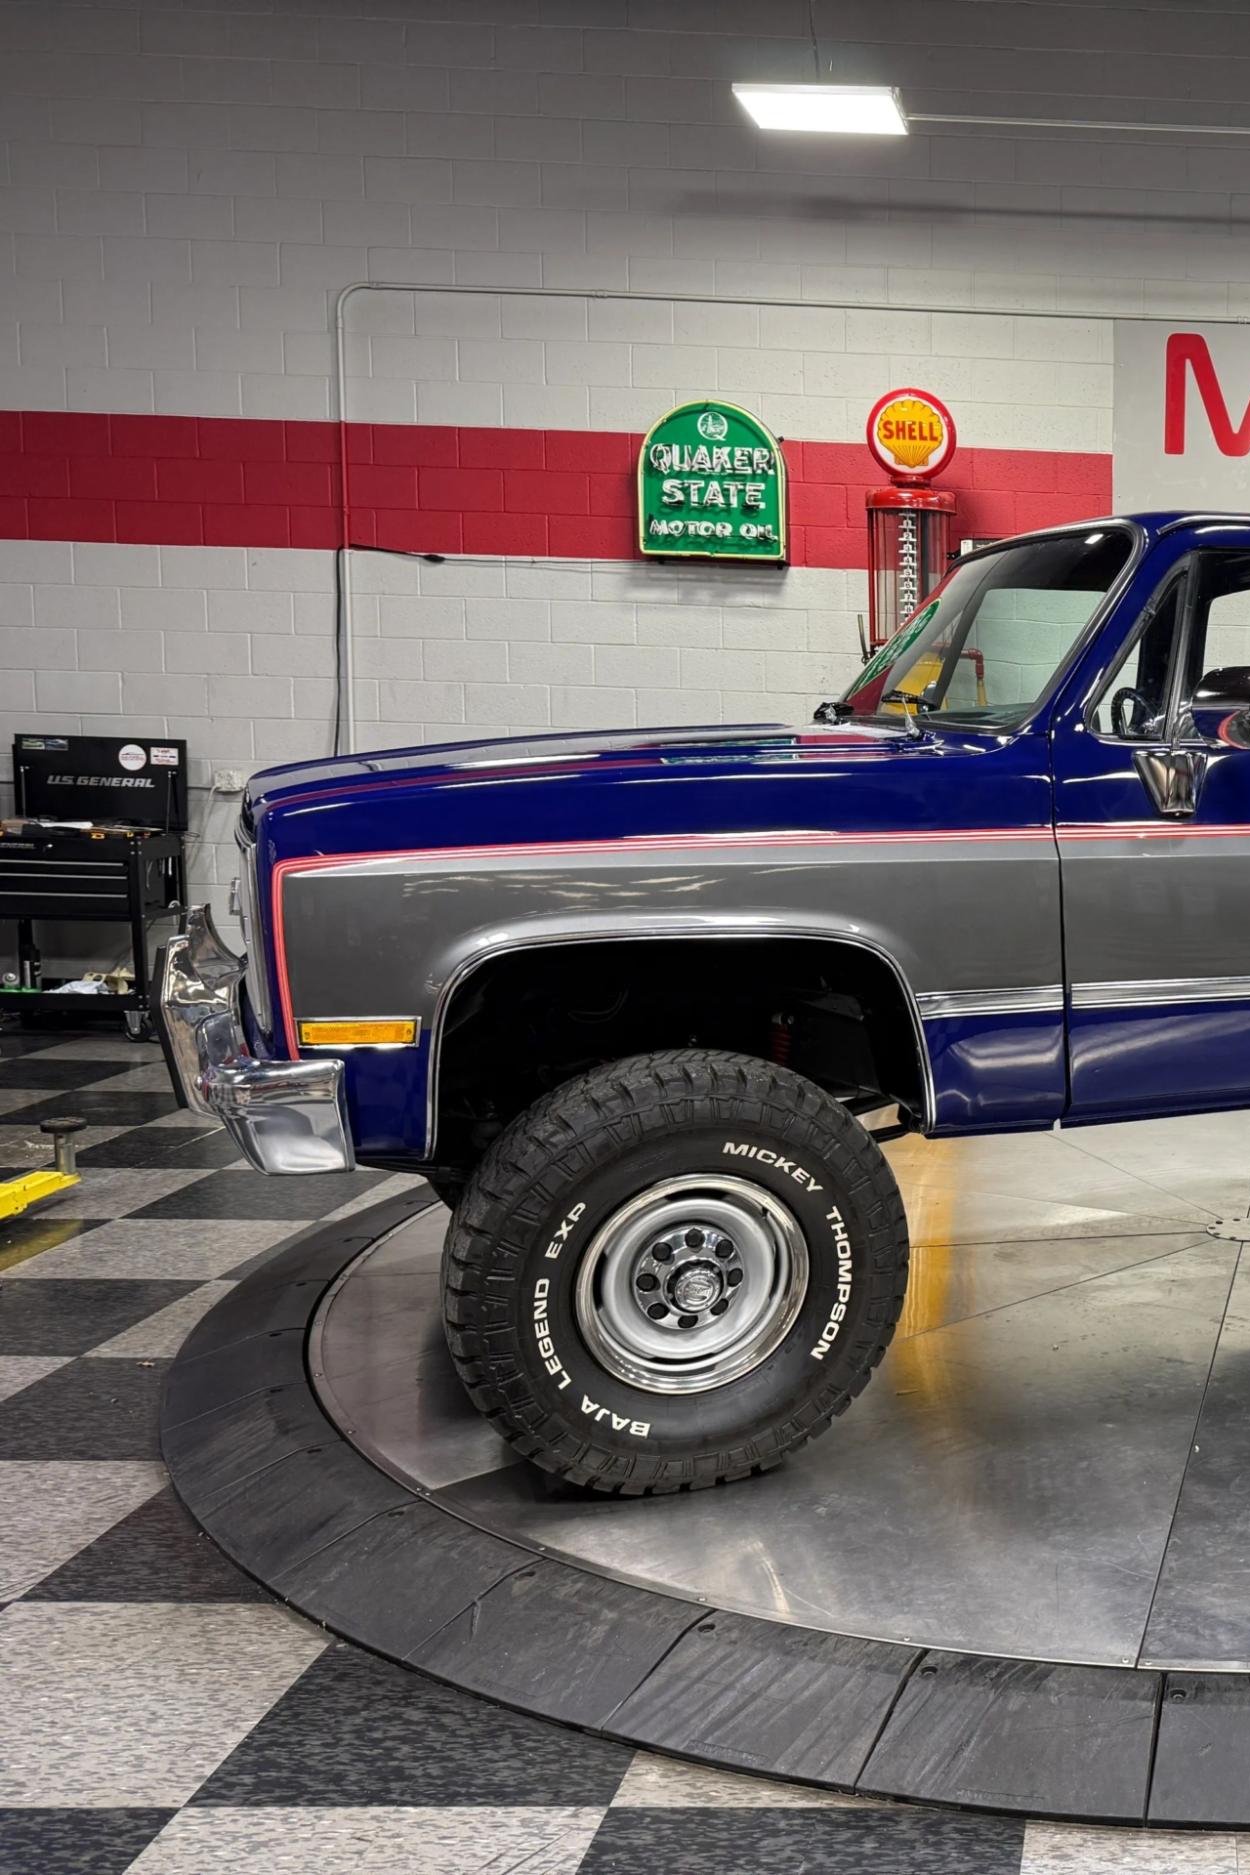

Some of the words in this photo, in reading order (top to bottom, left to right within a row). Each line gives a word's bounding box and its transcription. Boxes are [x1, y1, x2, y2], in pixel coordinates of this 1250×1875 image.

[882, 420, 939, 441] SHELL
[650, 443, 775, 475] QUAKER
[662, 479, 766, 509] STATE
[649, 519, 733, 537] MOTOR
[740, 523, 778, 540] OIL
[76, 777, 155, 788] GENERAL
[544, 1201, 587, 1260] EXP
[722, 1141, 824, 1194] MICKEY
[809, 1205, 853, 1361] THOMPSON
[533, 1277, 572, 1391] LEGEND
[580, 1393, 653, 1439] BAJA
